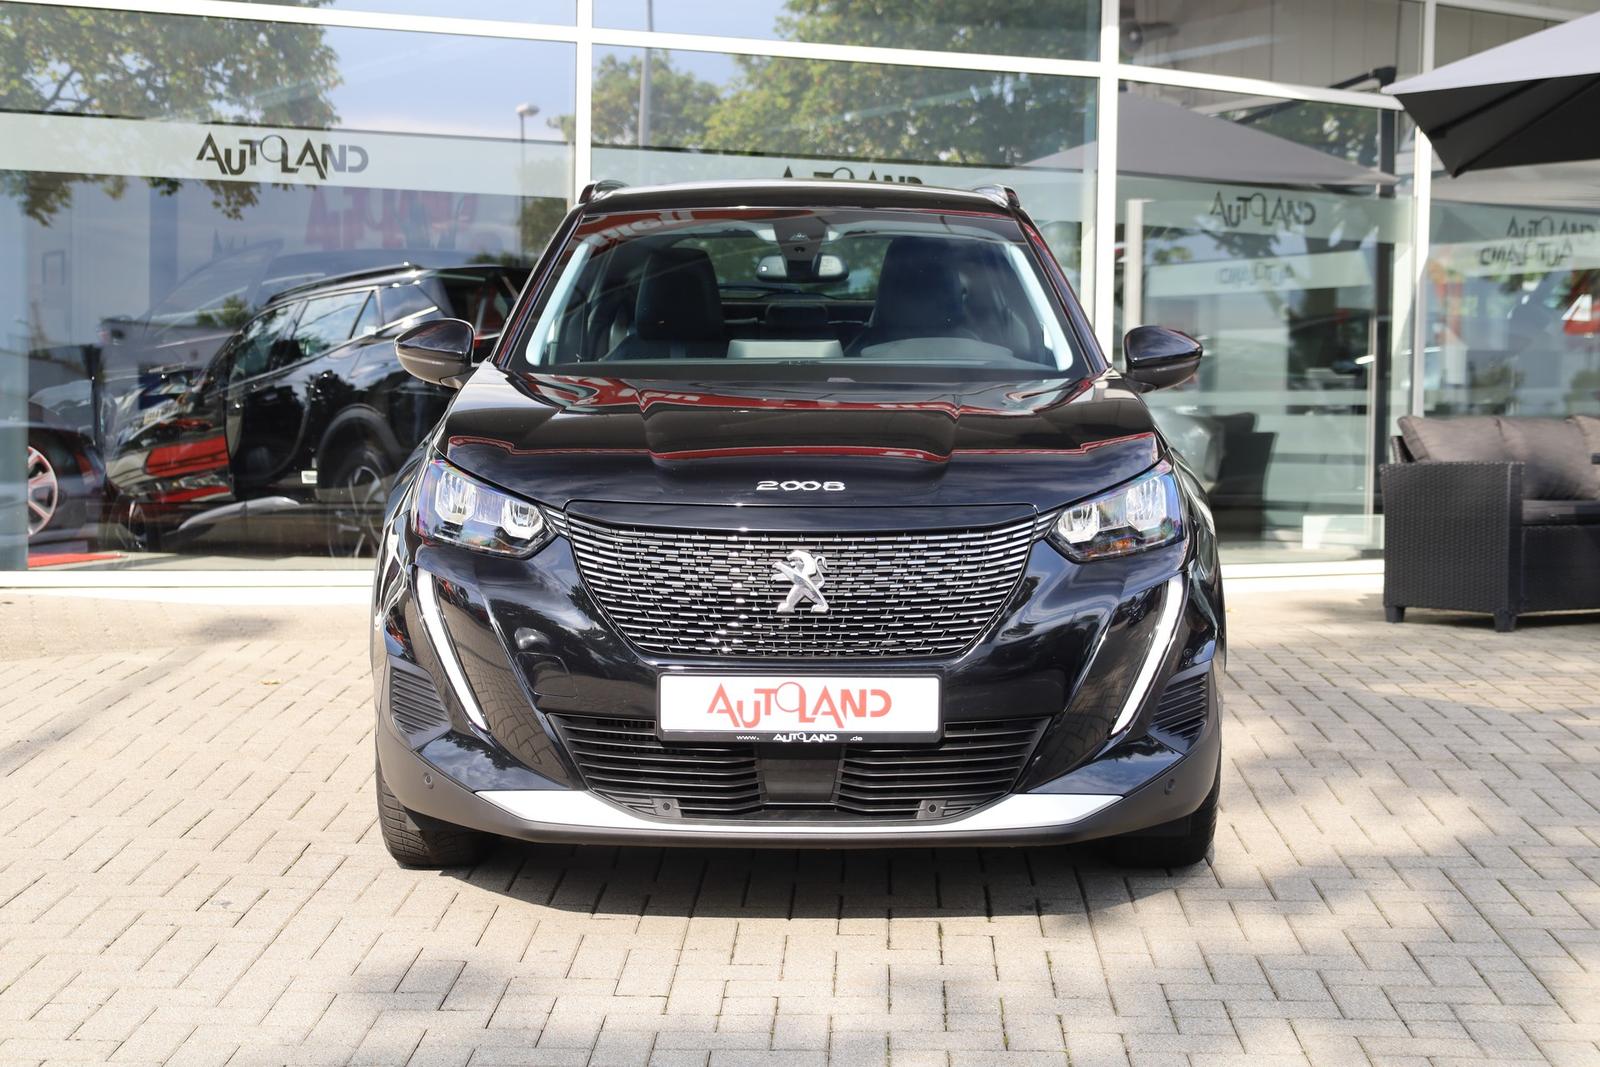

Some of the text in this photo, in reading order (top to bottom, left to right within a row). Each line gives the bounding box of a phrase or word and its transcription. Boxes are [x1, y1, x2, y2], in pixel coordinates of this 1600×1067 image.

[196, 131, 369, 180] AUTOLAND
[756, 480, 846, 491] 2008
[707, 681, 892, 728] AUTOLAND
[773, 732, 838, 743] AUTOLAND
